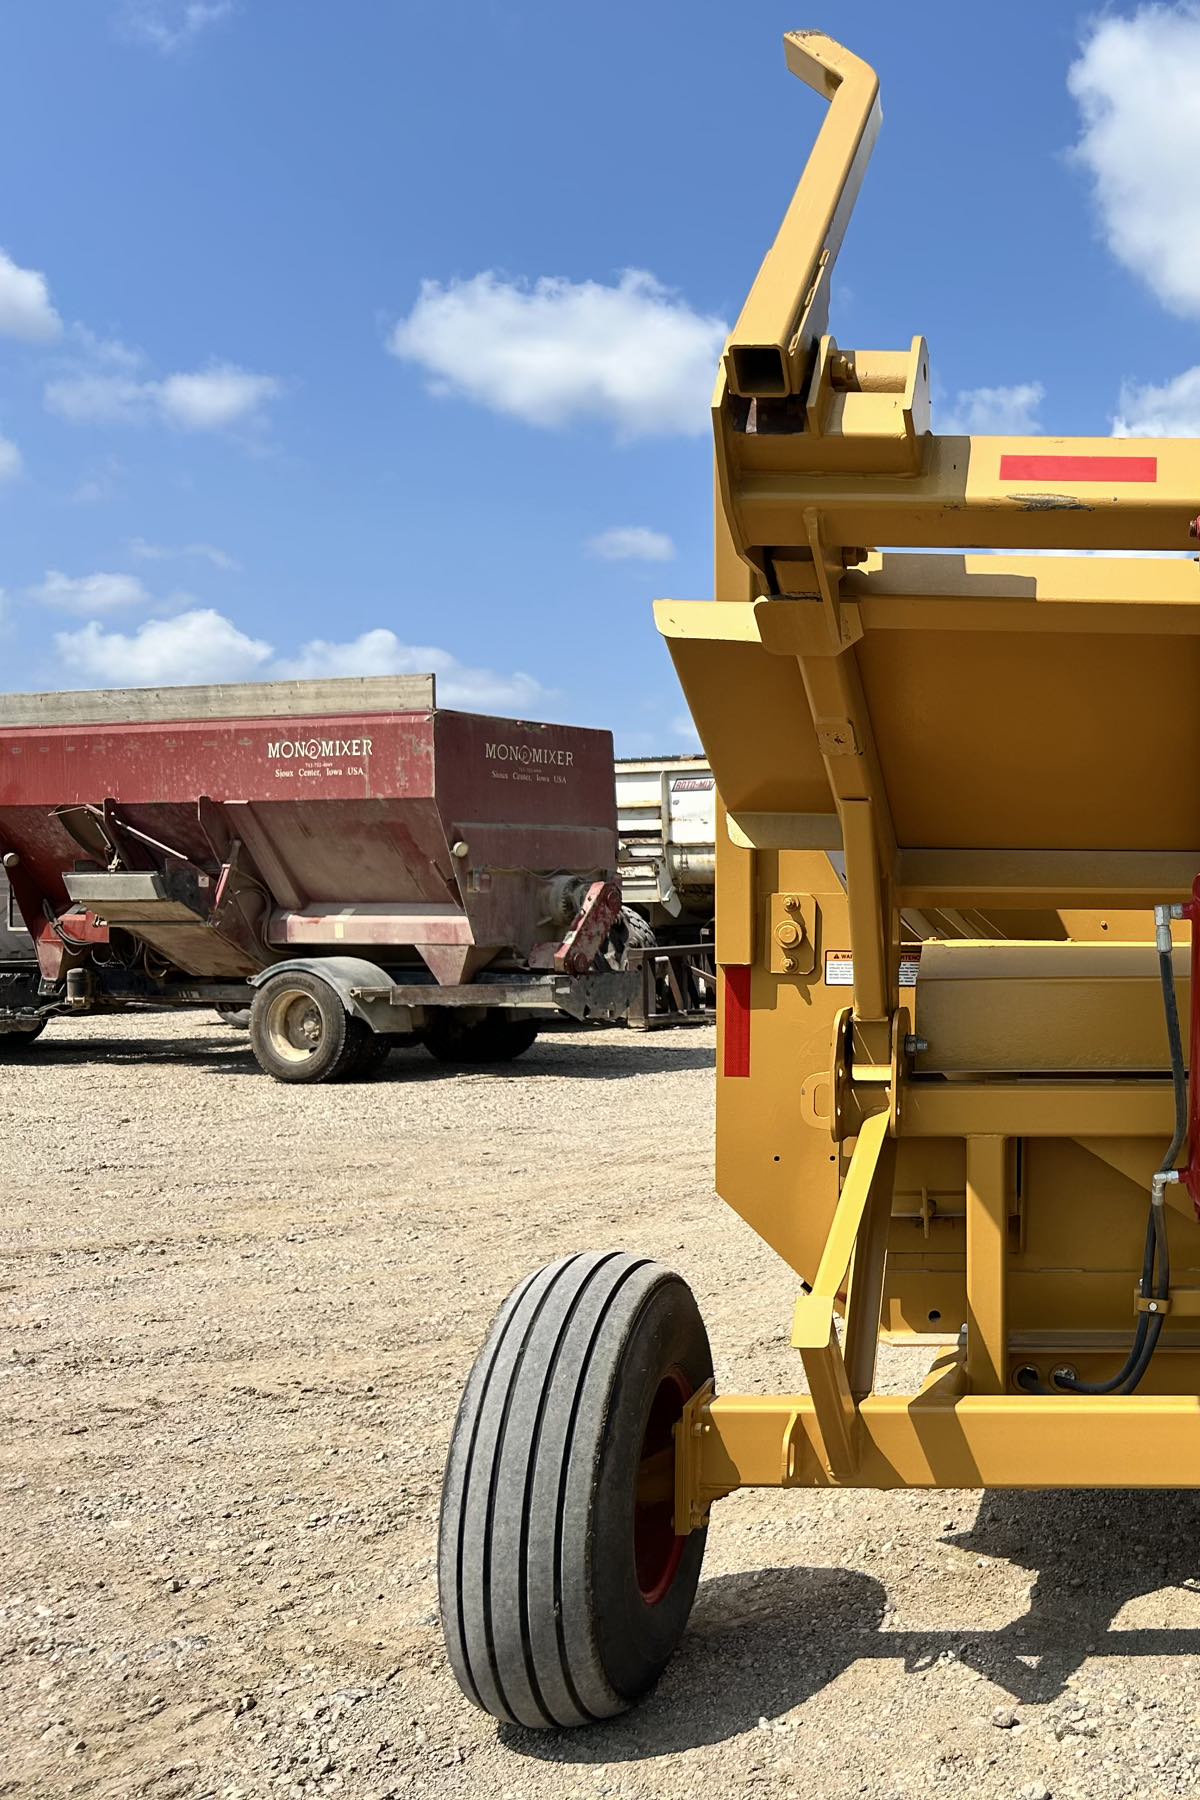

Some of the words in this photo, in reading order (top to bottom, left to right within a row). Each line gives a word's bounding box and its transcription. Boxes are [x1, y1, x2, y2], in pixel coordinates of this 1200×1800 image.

[275, 769, 294, 778] Sioux
[326, 768, 343, 776] Iowa
[347, 767, 364, 776] USA
[553, 775, 567, 784] USA
